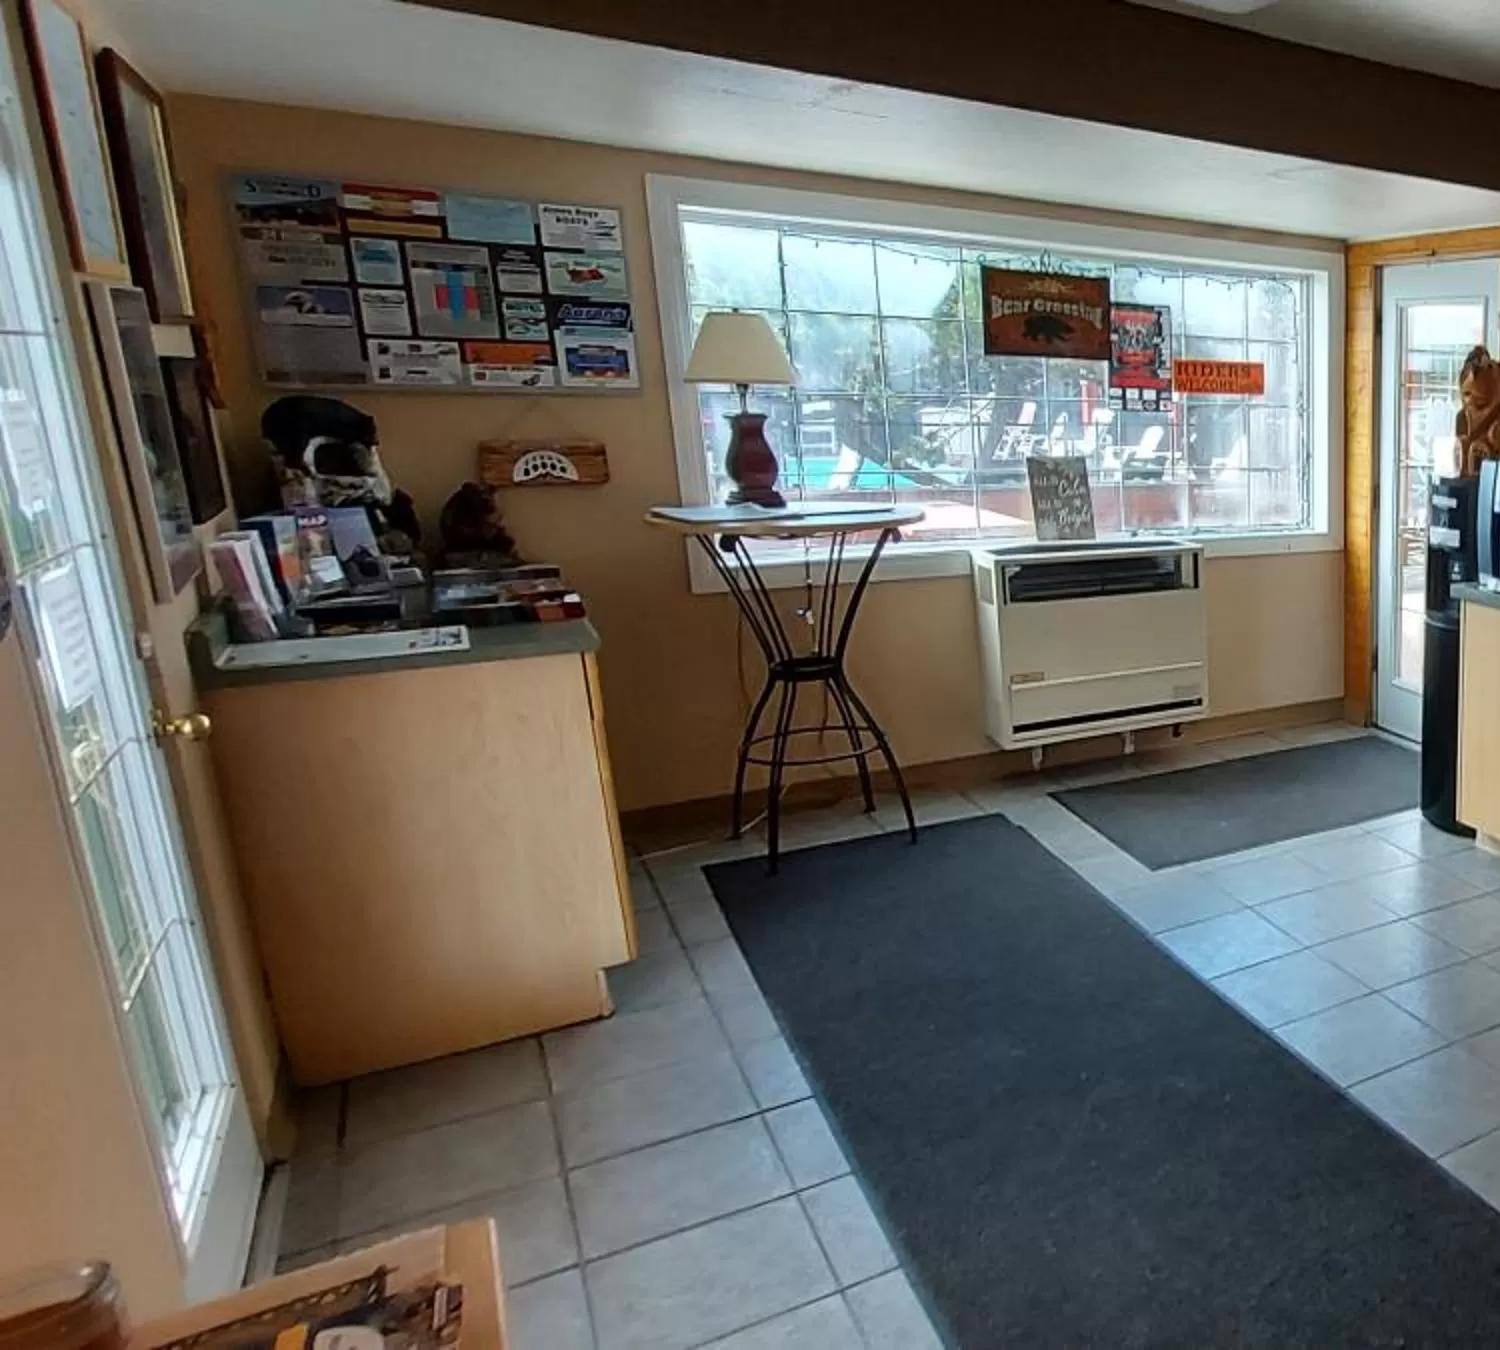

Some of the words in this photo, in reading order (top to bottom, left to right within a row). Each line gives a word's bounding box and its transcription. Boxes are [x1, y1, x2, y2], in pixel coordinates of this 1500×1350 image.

[991, 295, 1031, 319] Bear
[1033, 298, 1102, 330] Crossing
[1176, 362, 1250, 379] RIDERS
[1176, 378, 1244, 394] WELCOME
